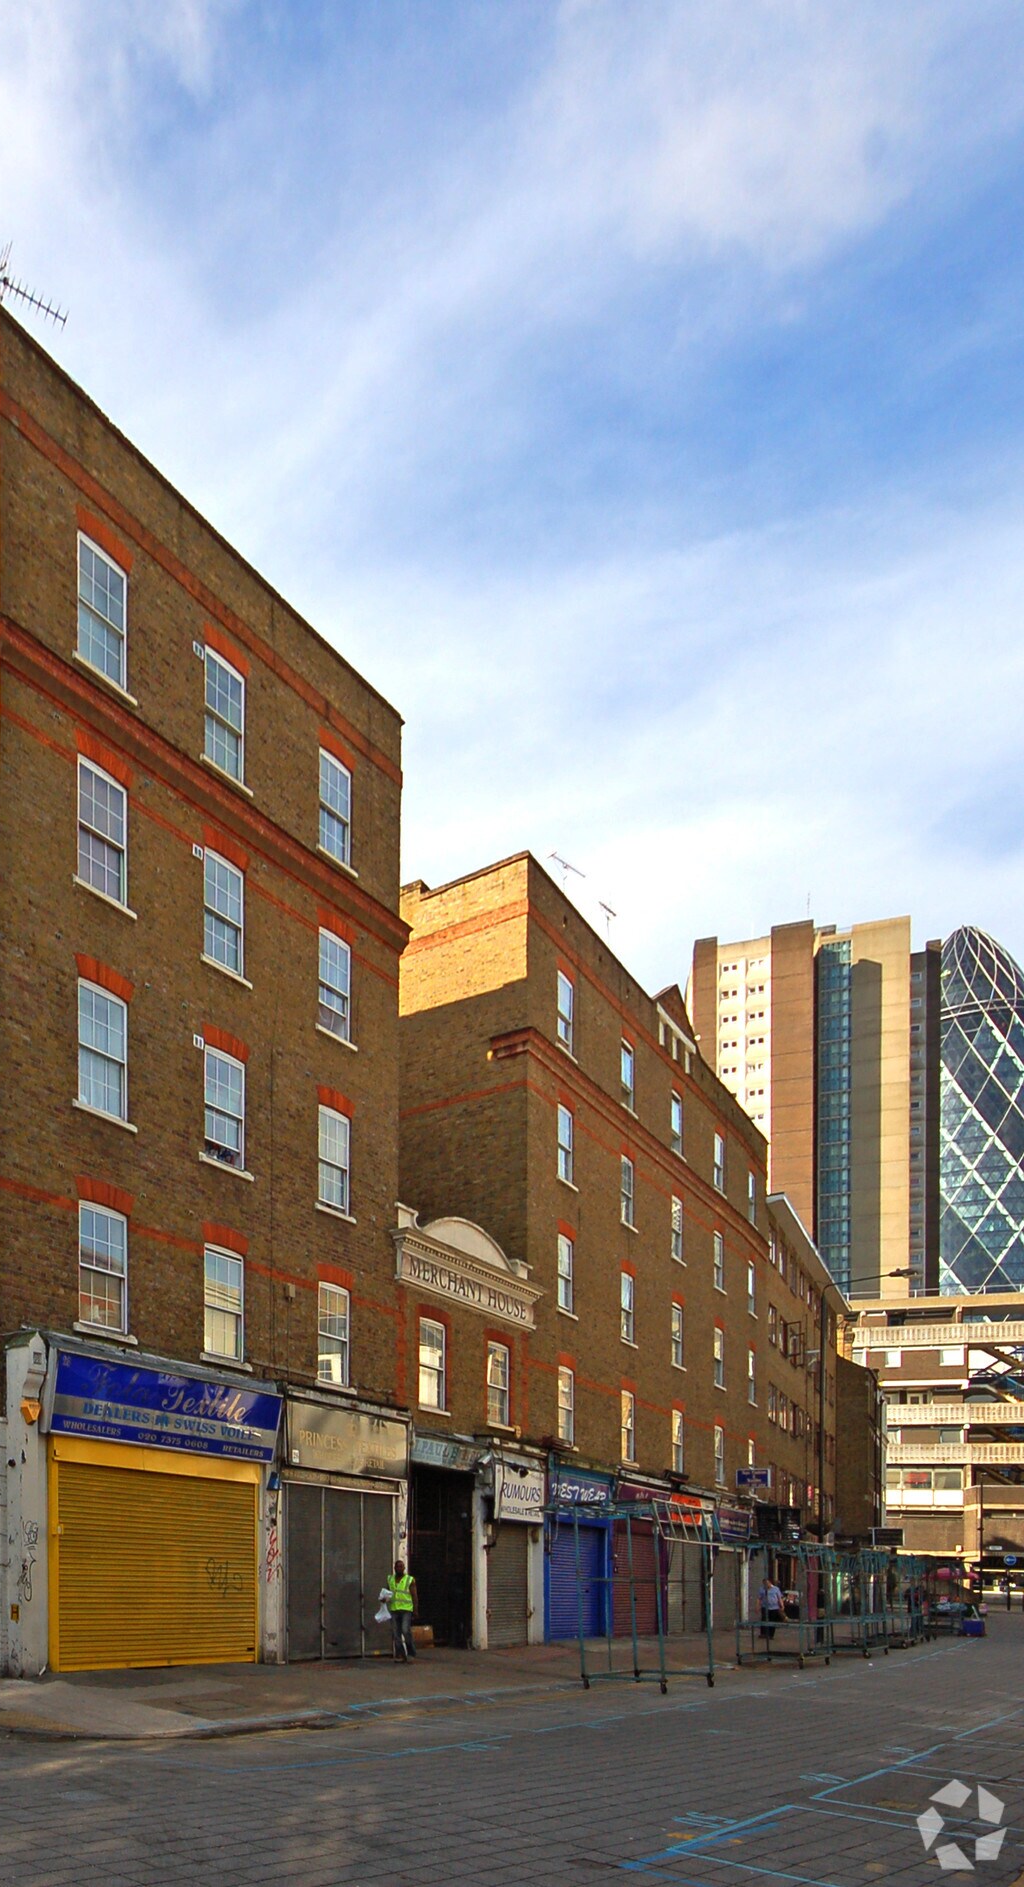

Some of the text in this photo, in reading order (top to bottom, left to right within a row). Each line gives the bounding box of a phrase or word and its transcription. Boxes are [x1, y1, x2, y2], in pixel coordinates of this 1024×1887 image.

[409, 1256, 527, 1320] MERCHANT HOUSE
[83, 1403, 150, 1424] DEALERS
[174, 1419, 216, 1435] SWISS
[162, 1382, 251, 1422] Textile
[63, 1420, 264, 1458] WHOLESALERS 020 7375 0608 RETAILERS
[502, 1482, 542, 1503] RUMOURS
